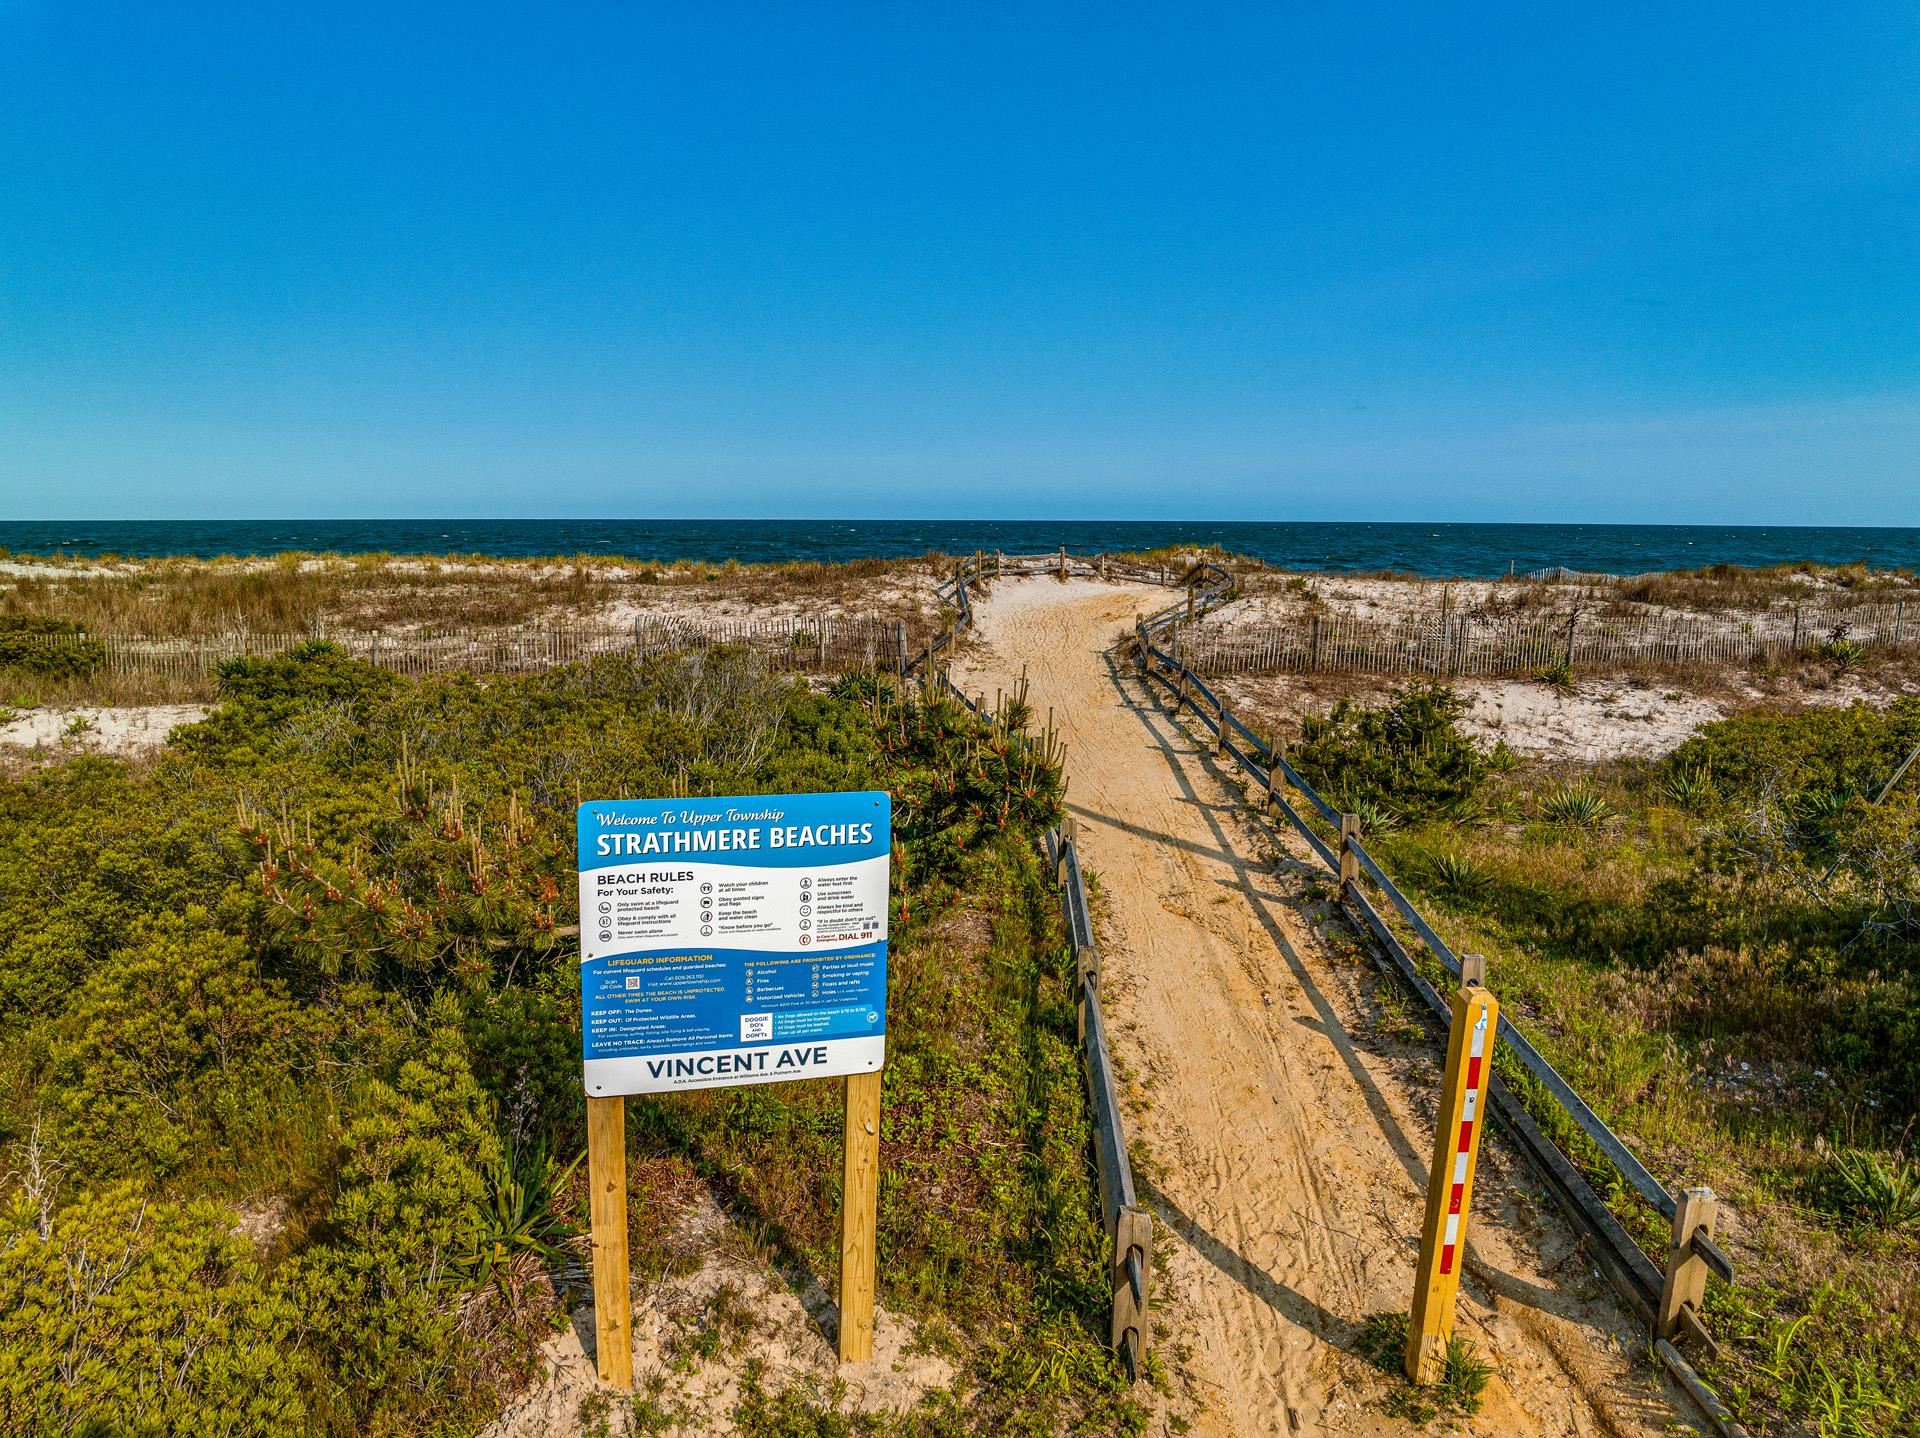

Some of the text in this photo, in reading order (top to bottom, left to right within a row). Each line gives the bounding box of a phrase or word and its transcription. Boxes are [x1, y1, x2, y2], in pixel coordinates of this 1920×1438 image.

[596, 808, 784, 826] Welcome To Upper Township
[597, 823, 873, 856] STRATHMERE BEACHES
[598, 872, 694, 885] BEACH RULES
[608, 955, 713, 966] LIFEGUARD INFORMATION
[647, 1047, 828, 1078] VINCENT AVE
